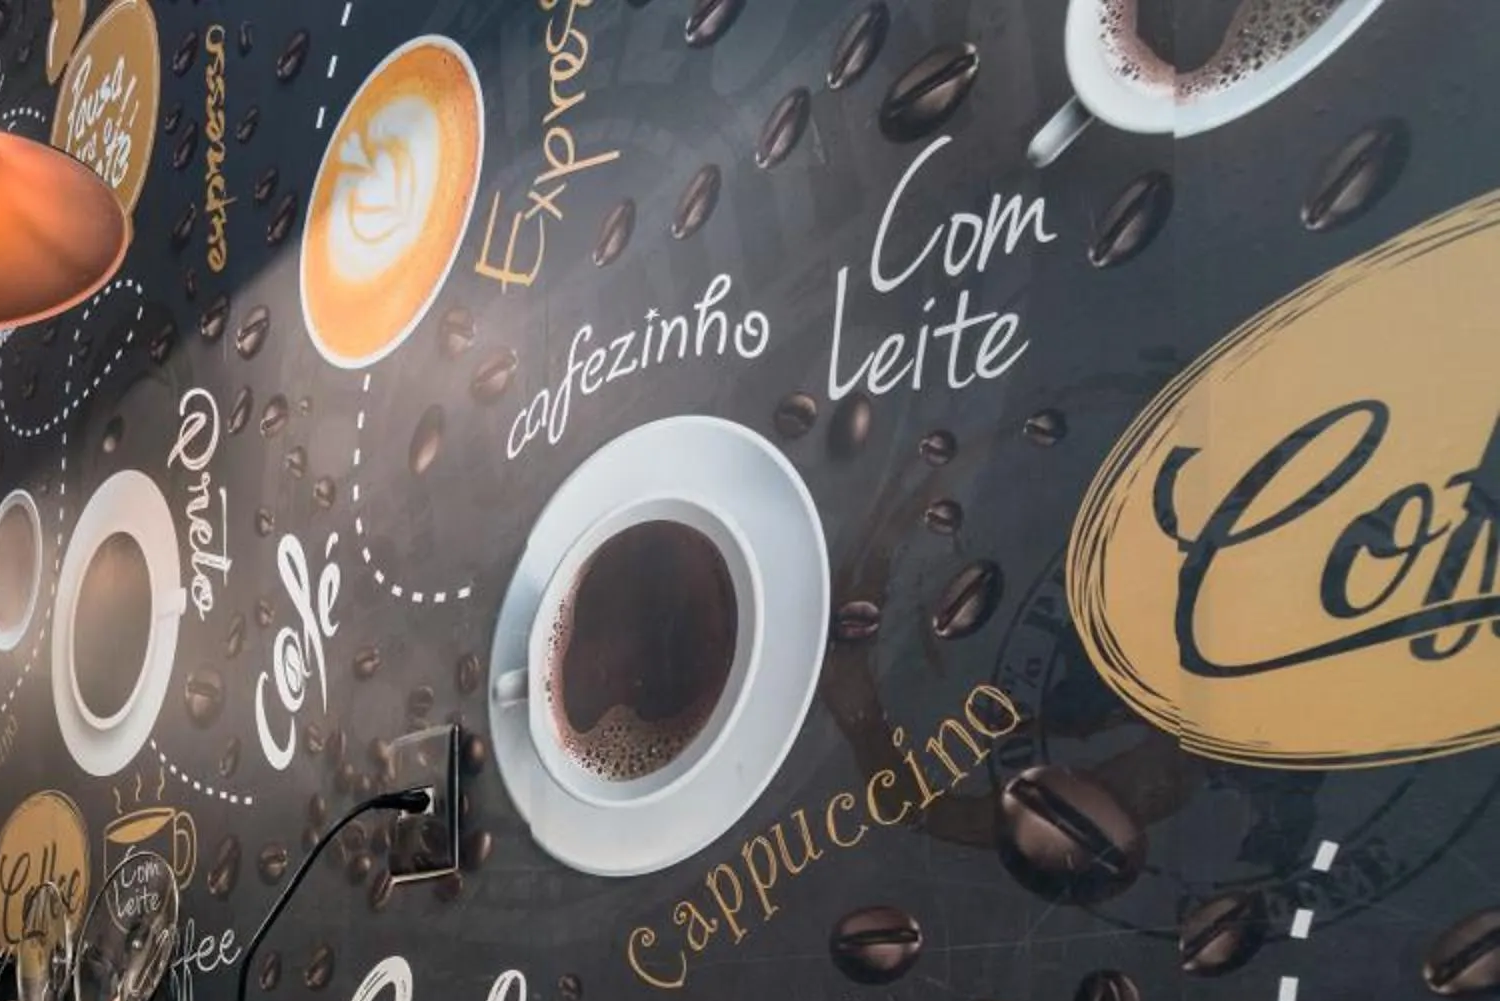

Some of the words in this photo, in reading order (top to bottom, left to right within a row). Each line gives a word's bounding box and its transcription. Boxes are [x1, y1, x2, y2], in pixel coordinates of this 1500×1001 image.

[475, 0, 620, 294] Expres
[870, 134, 1057, 295] Com
[505, 273, 770, 459] cafezinho
[826, 266, 1030, 401] Leite
[1152, 398, 1500, 678] Cof
[255, 531, 341, 771] Café
[113, 880, 161, 919] Leite
[121, 844, 160, 888] Com
[627, 684, 1023, 989] Cappuccino
